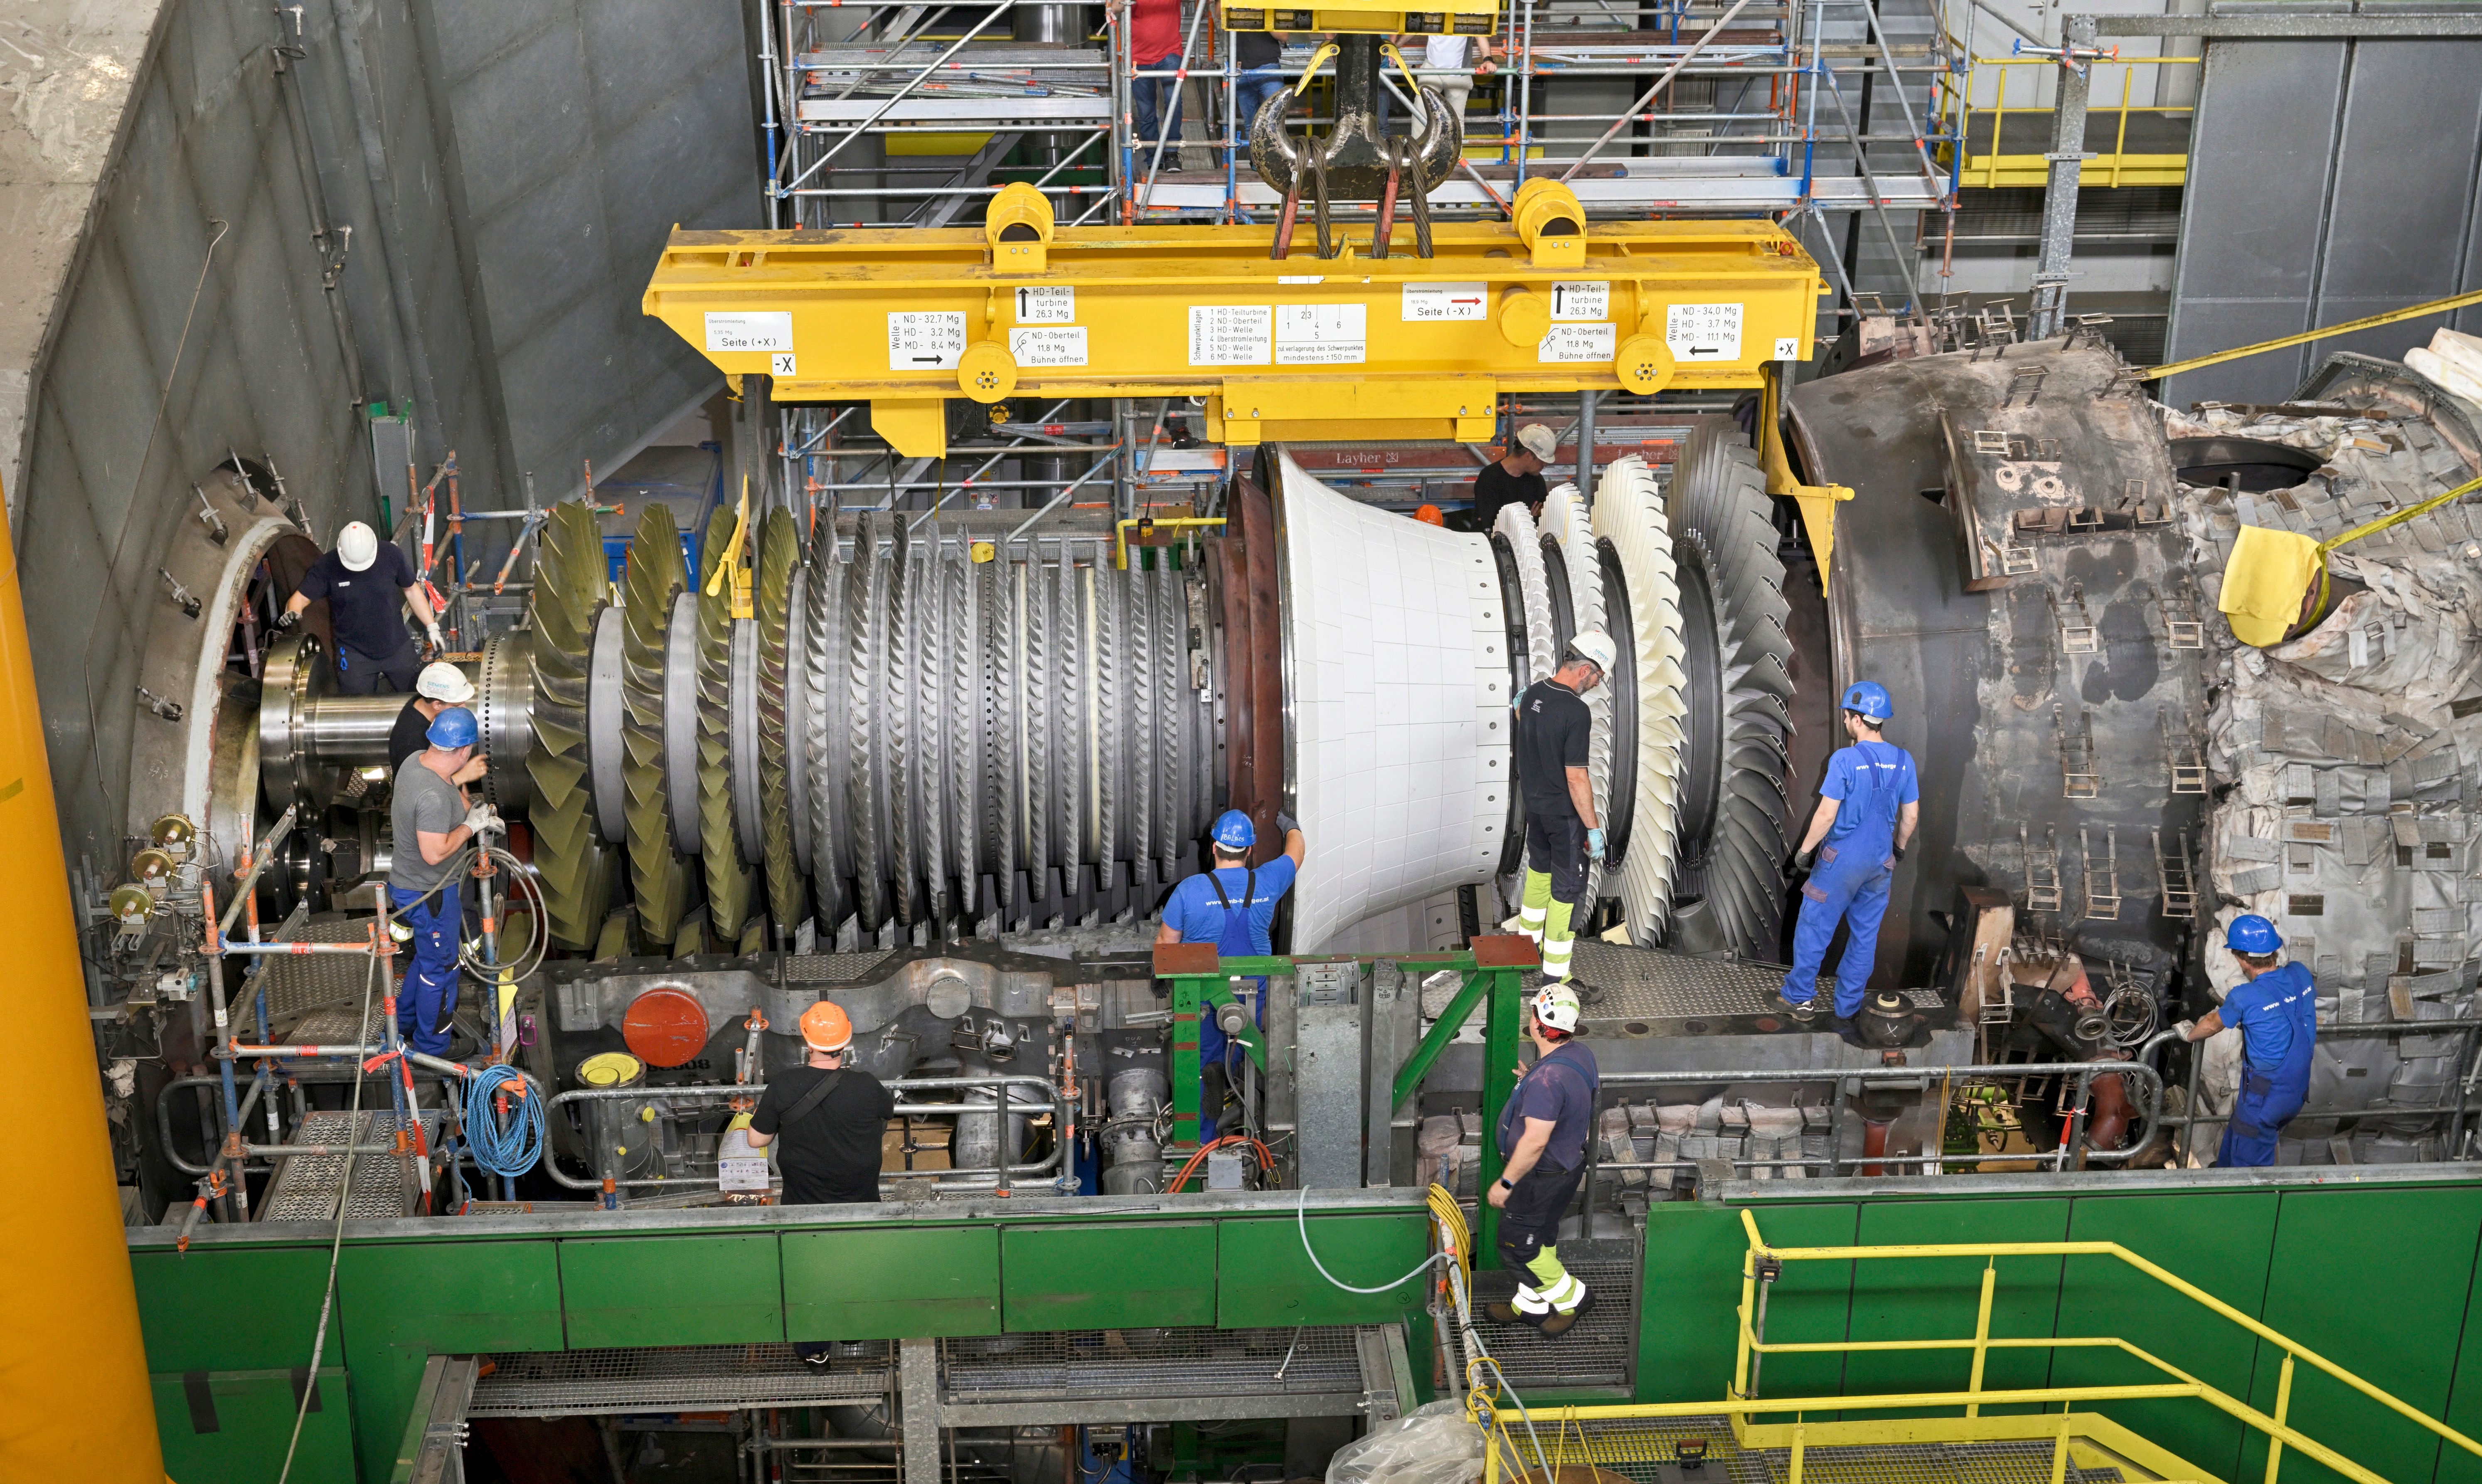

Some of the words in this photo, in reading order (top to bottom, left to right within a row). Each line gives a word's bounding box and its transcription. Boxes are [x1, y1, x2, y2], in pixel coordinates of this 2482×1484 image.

[1057, 310, 1068, 319] Mg
[1591, 308, 1601, 316] Mg
[1725, 307, 1736, 316] Mg
[947, 315, 958, 324] Mg
[1724, 320, 1735, 328] Mg
[948, 328, 960, 337] Mg
[1724, 333, 1734, 342] Mg
[949, 341, 960, 350] Mg
[1779, 344, 1793, 355] +X
[776, 357, 792, 372] -X
[1337, 452, 1381, 465] Layher
[1595, 648, 1609, 661] SIEMENS
